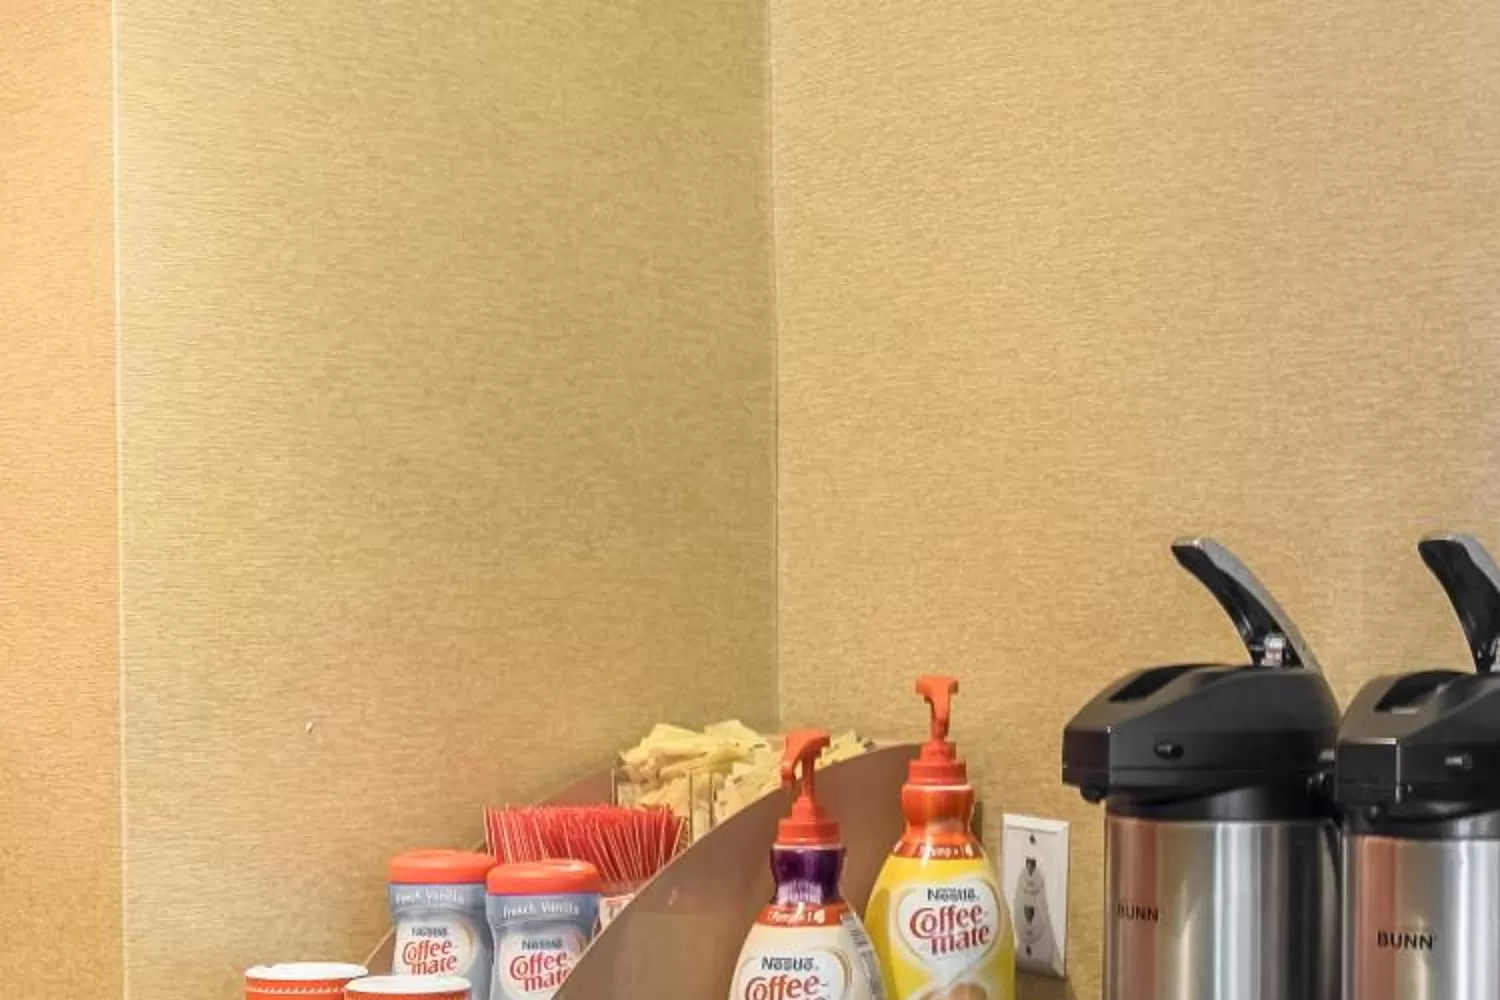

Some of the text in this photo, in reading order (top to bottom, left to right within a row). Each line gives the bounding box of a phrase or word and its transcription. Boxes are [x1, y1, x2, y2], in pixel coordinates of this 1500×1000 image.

[1116, 903, 1159, 921] BUNN
[930, 925, 990, 956] mate
[1377, 931, 1433, 952] BUNN
[411, 955, 458, 976] mate
